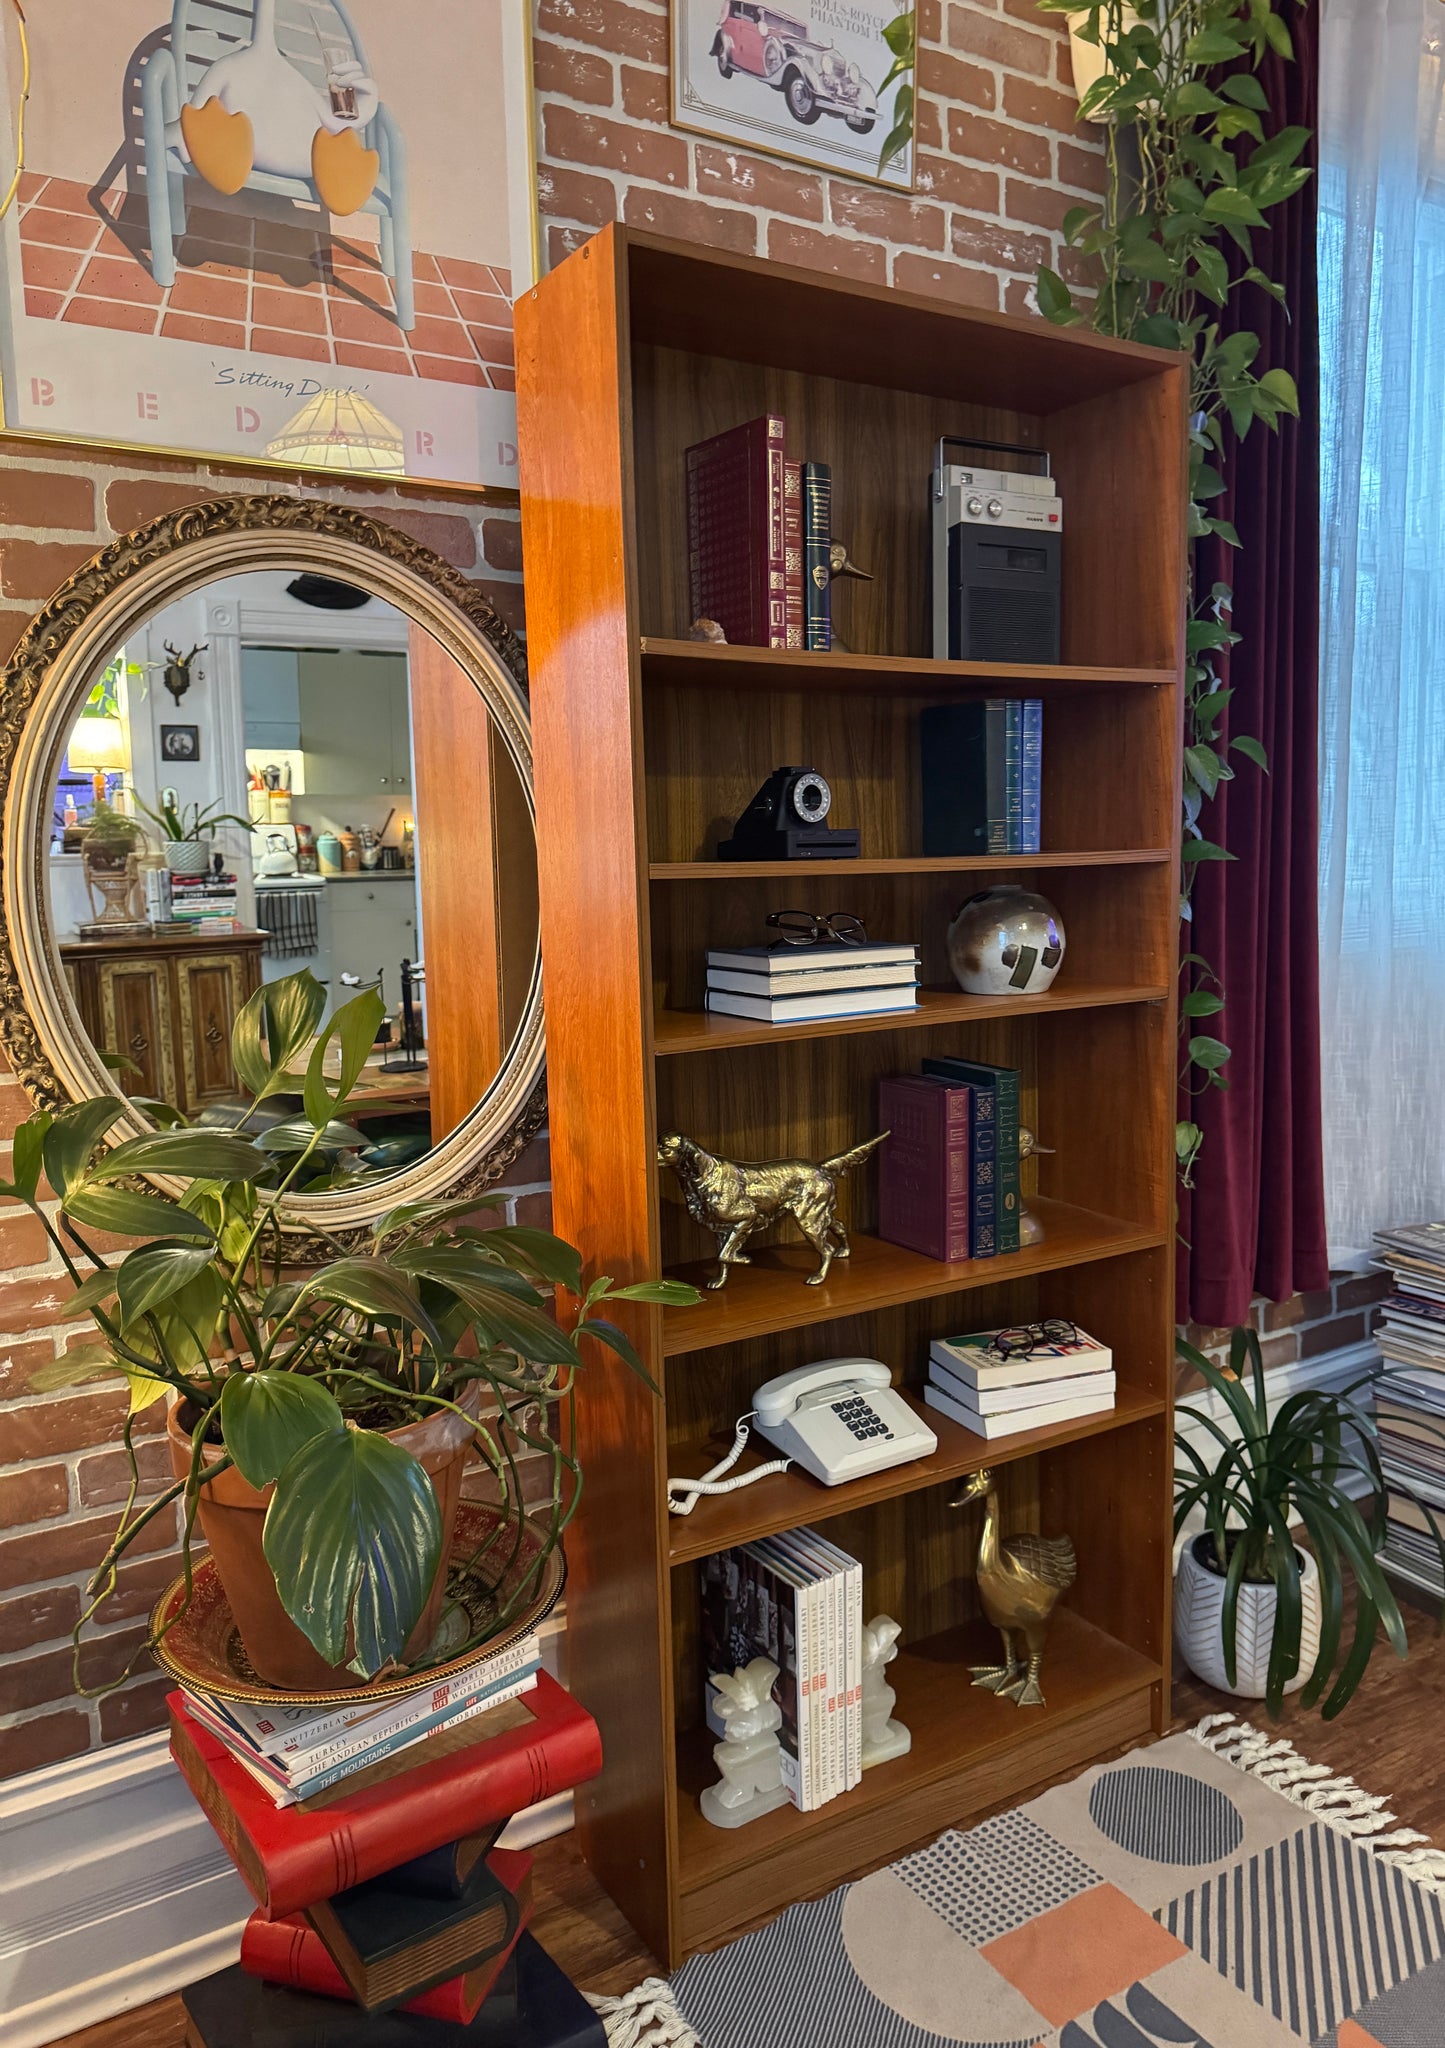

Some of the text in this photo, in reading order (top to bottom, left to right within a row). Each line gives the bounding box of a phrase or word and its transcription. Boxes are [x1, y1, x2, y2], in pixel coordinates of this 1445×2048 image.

[810, 7, 870, 38] PHANTOM
[283, 1711, 356, 1745] SWITZERLAND
[308, 1738, 348, 1763] TURKEY
[433, 1685, 450, 1700] LIFE
[453, 1668, 486, 1688] WORLD
[490, 1647, 526, 1669] LIBRARY
[308, 1658, 525, 1776] THE ANDEAN REPUBLICS LIFE WORLD LIBRARY
[427, 1686, 525, 1738] LIFE WORLD LIBRARY
[320, 1773, 338, 1789] THE
[340, 1743, 391, 1777] MOUNTAINS
[465, 1696, 478, 1707] LIFE
